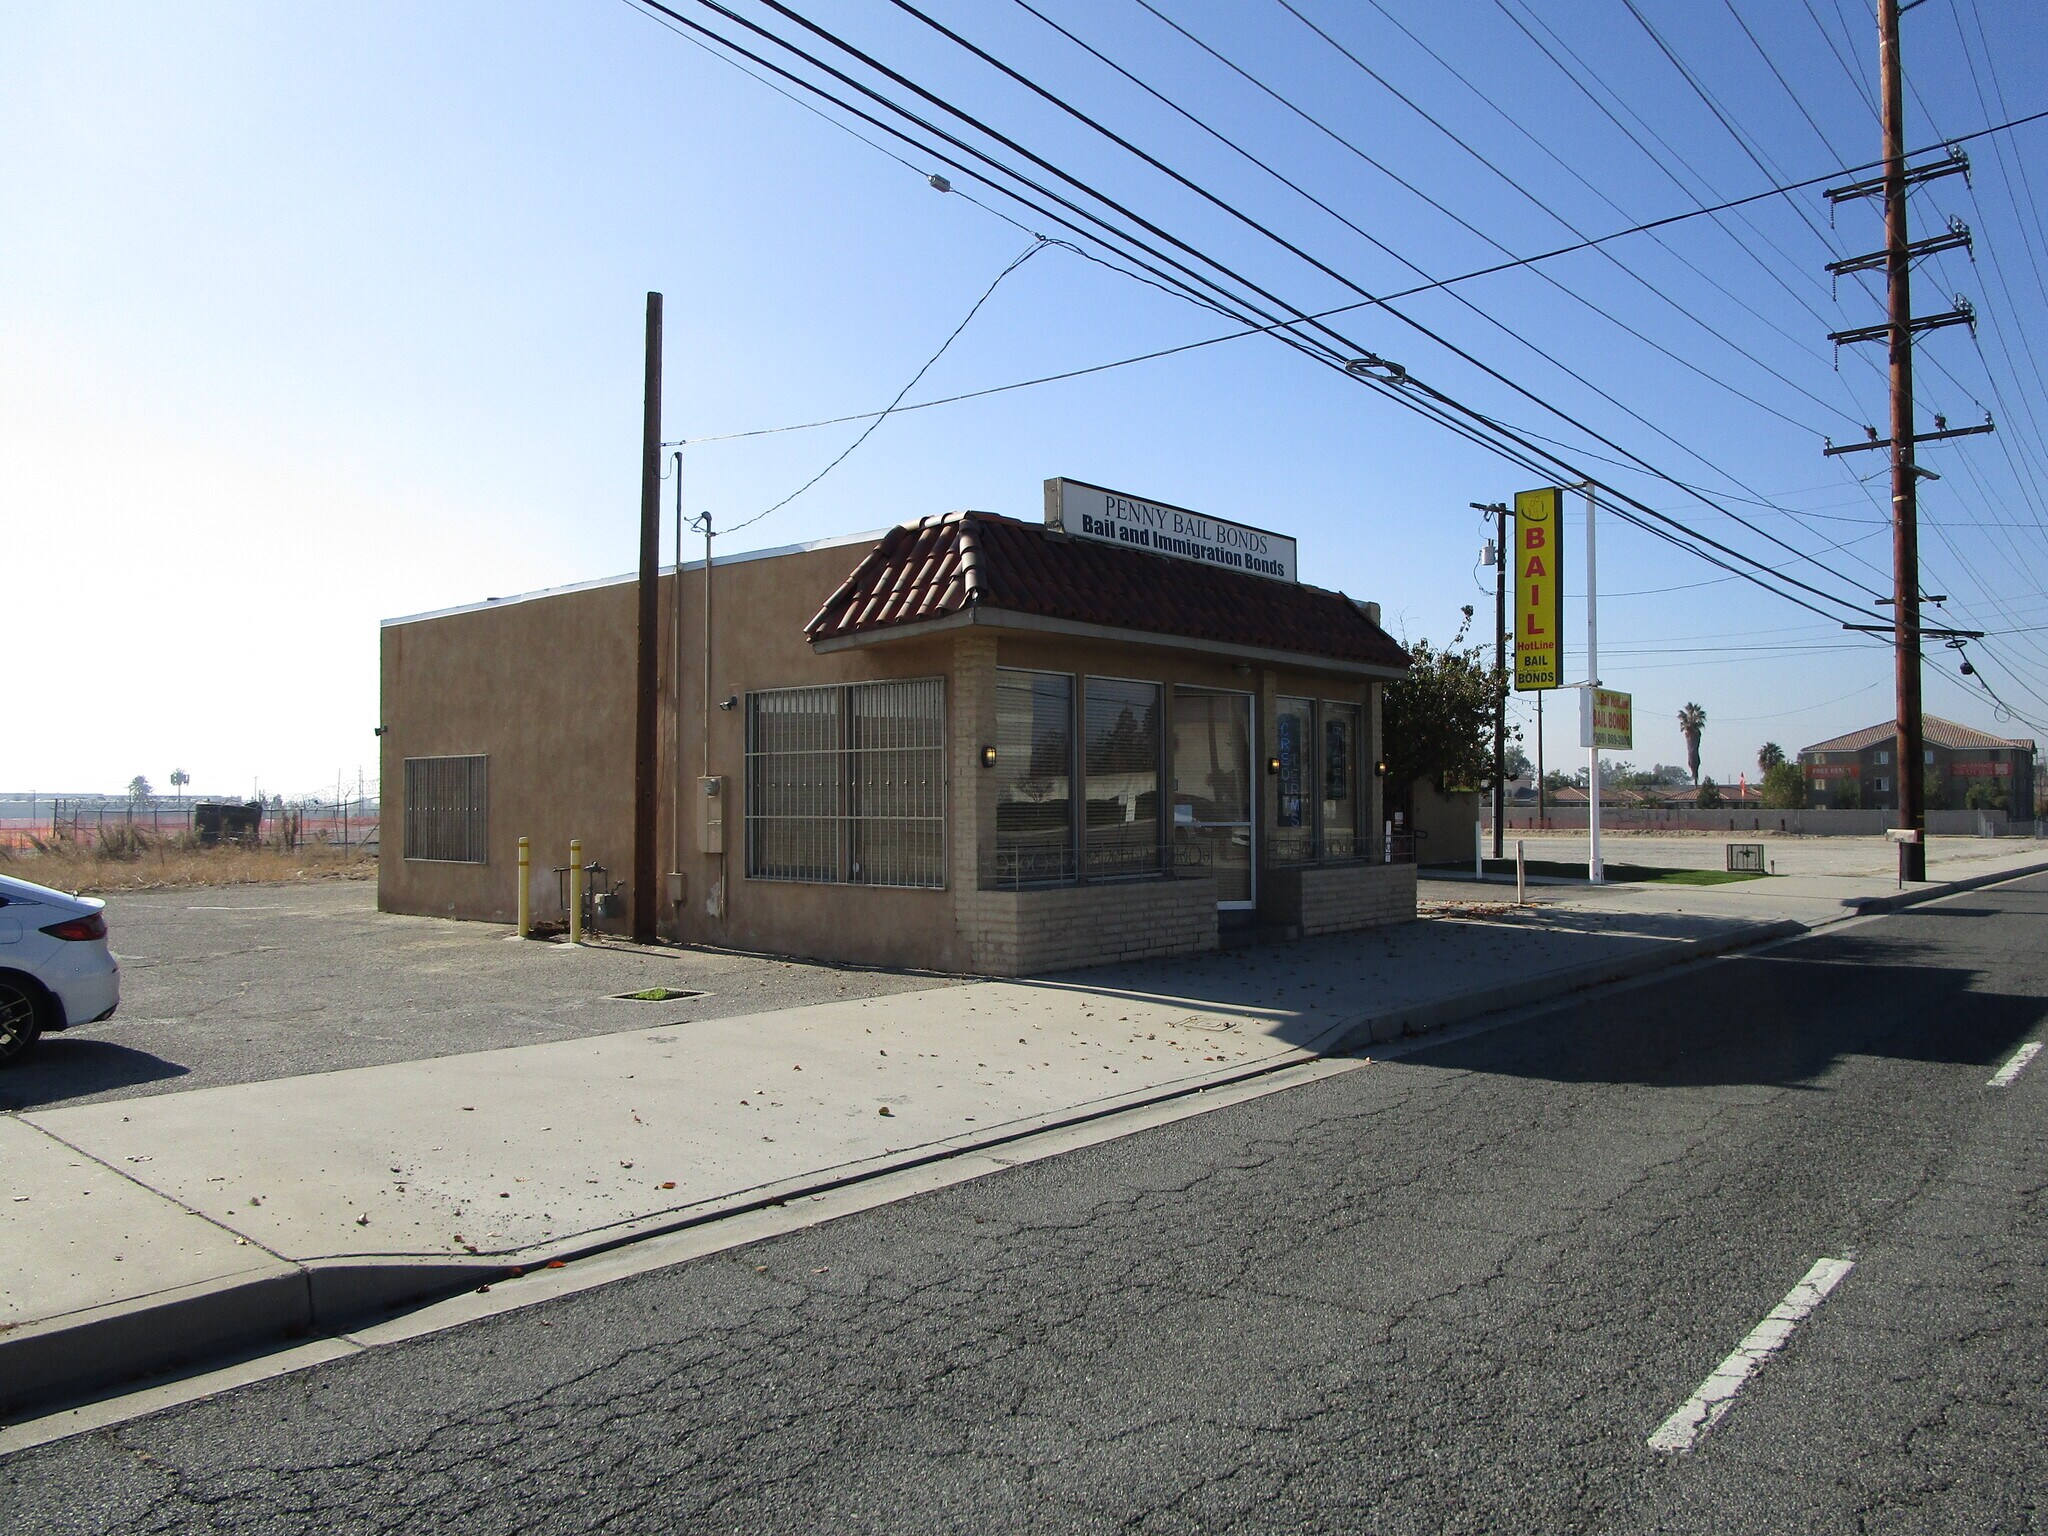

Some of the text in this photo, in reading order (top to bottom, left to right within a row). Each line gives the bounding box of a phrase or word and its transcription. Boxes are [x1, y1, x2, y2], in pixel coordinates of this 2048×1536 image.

[1105, 495, 1268, 555] PENNY BAIL BONDS
[1082, 513, 1285, 577] Bail and Immigration Bonds
[1524, 526, 1546, 635] BAIL
[1517, 640, 1554, 651] HotLine
[1524, 655, 1548, 667] BAIL
[1518, 671, 1554, 684] BONDS
[1593, 709, 1629, 731] BAIL BONDS
[1812, 767, 1829, 775] FREE
